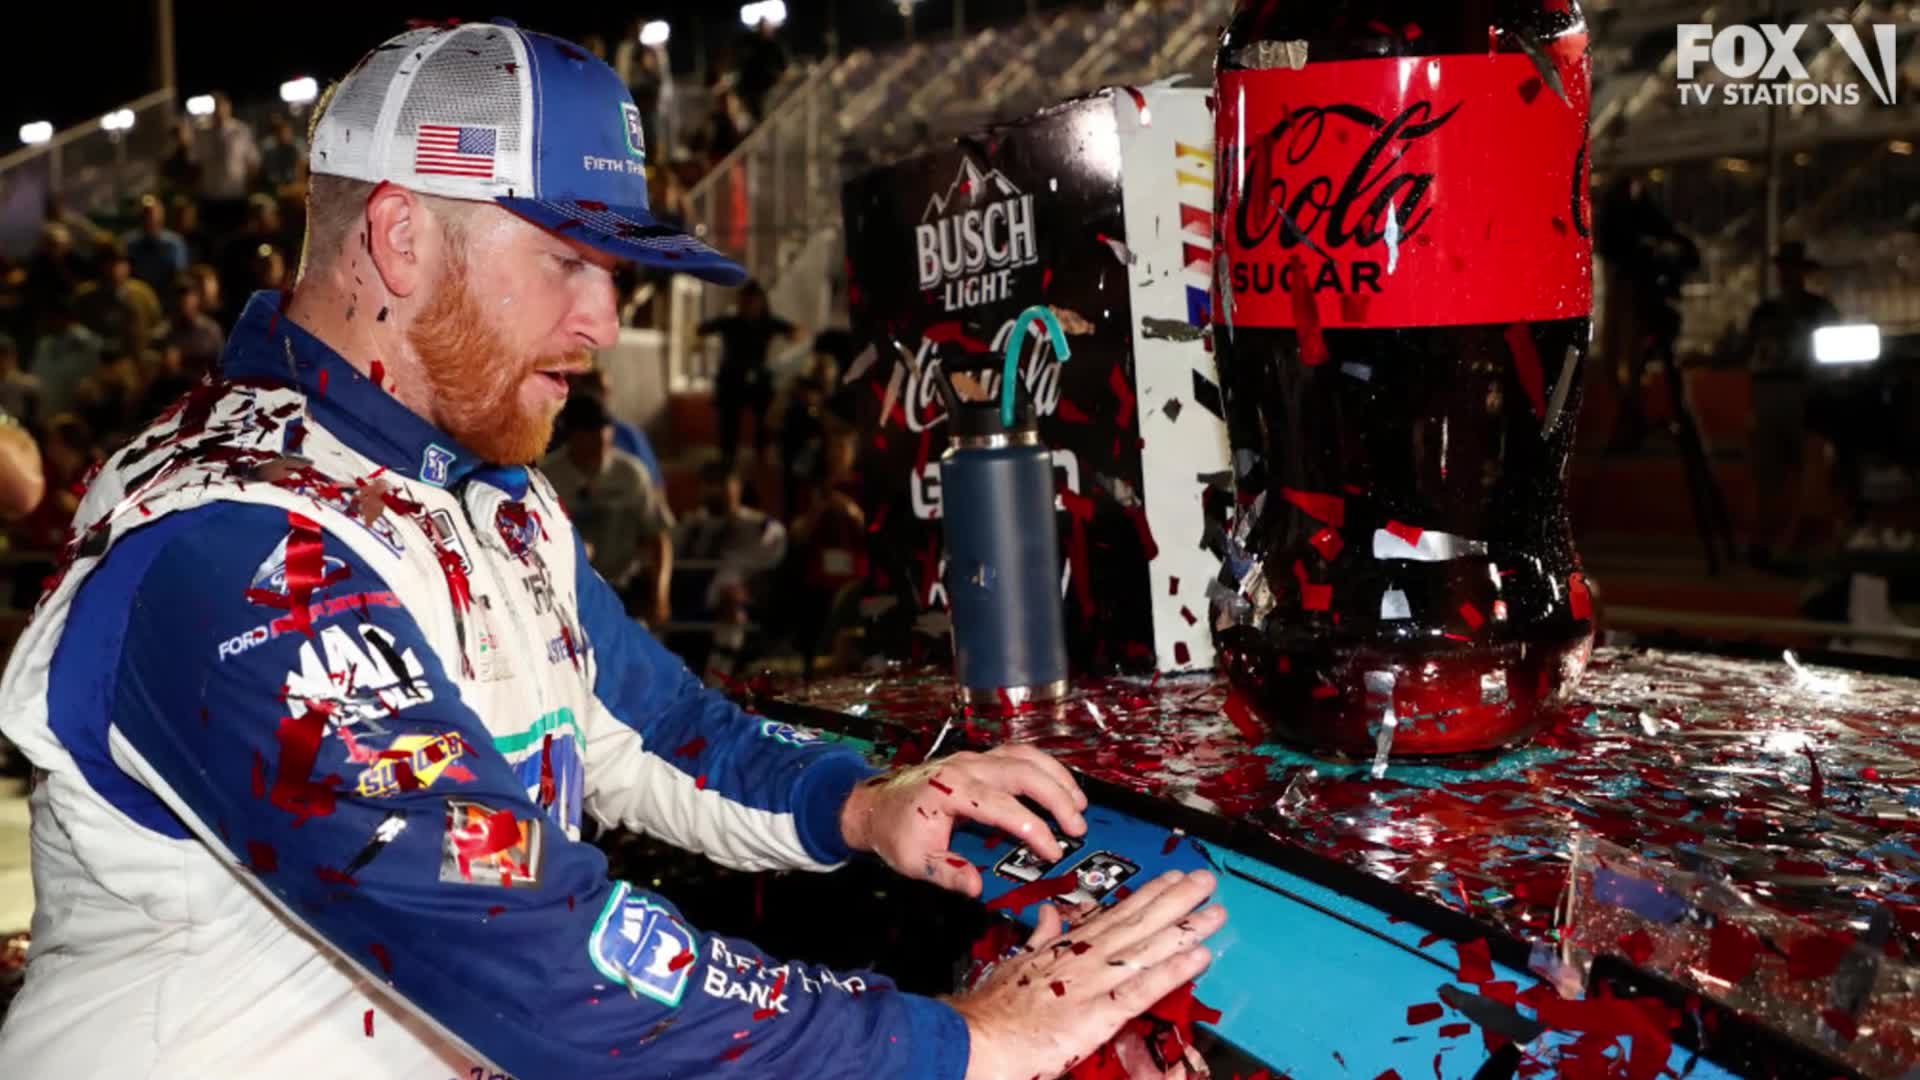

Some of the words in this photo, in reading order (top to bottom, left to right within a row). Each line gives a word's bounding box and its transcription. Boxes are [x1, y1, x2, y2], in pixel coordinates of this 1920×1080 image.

[916, 194, 1039, 291] BUSCH
[944, 268, 1011, 312] LIGHT
[218, 625, 269, 662] FORD
[703, 964, 790, 1014] BANK
